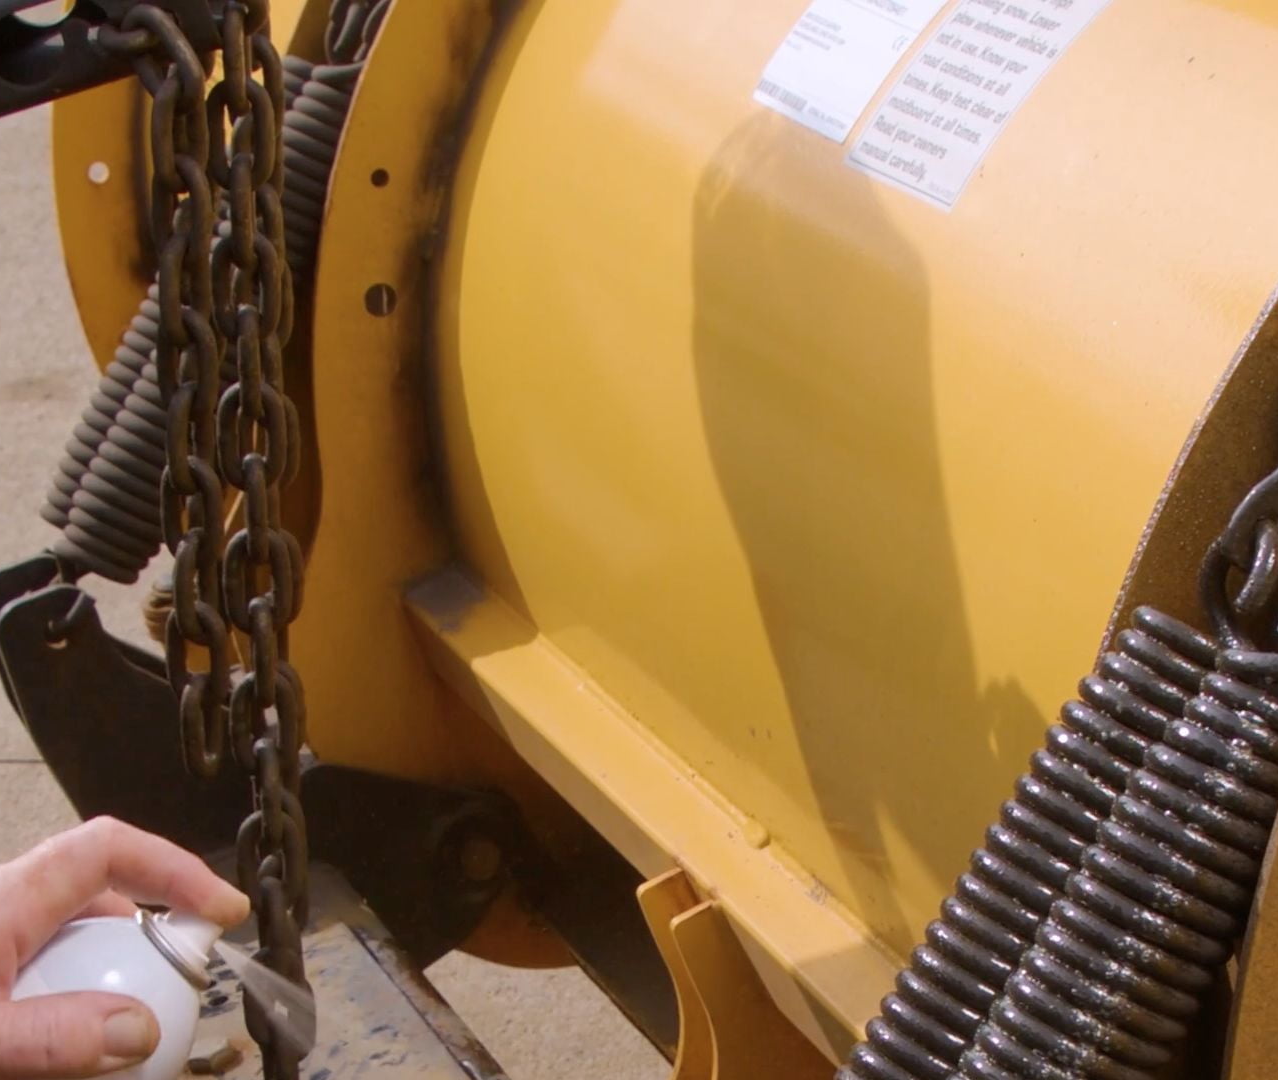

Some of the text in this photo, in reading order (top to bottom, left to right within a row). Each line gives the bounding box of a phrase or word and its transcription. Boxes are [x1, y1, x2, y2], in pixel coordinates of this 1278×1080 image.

[953, 12, 1058, 58] plow whenever vehicle is
[1030, 13, 1060, 33] Lower
[919, 51, 1010, 95] road conditions at all
[936, 31, 954, 45] not
[951, 36, 964, 49] in
[979, 48, 1007, 66] Know
[1003, 60, 1027, 78] your
[888, 95, 984, 144] moldboard at all times.
[903, 74, 1007, 124] times. Keep feet clear of
[872, 116, 899, 136] Read
[892, 129, 916, 147] your
[858, 141, 930, 182] manual carefully.
